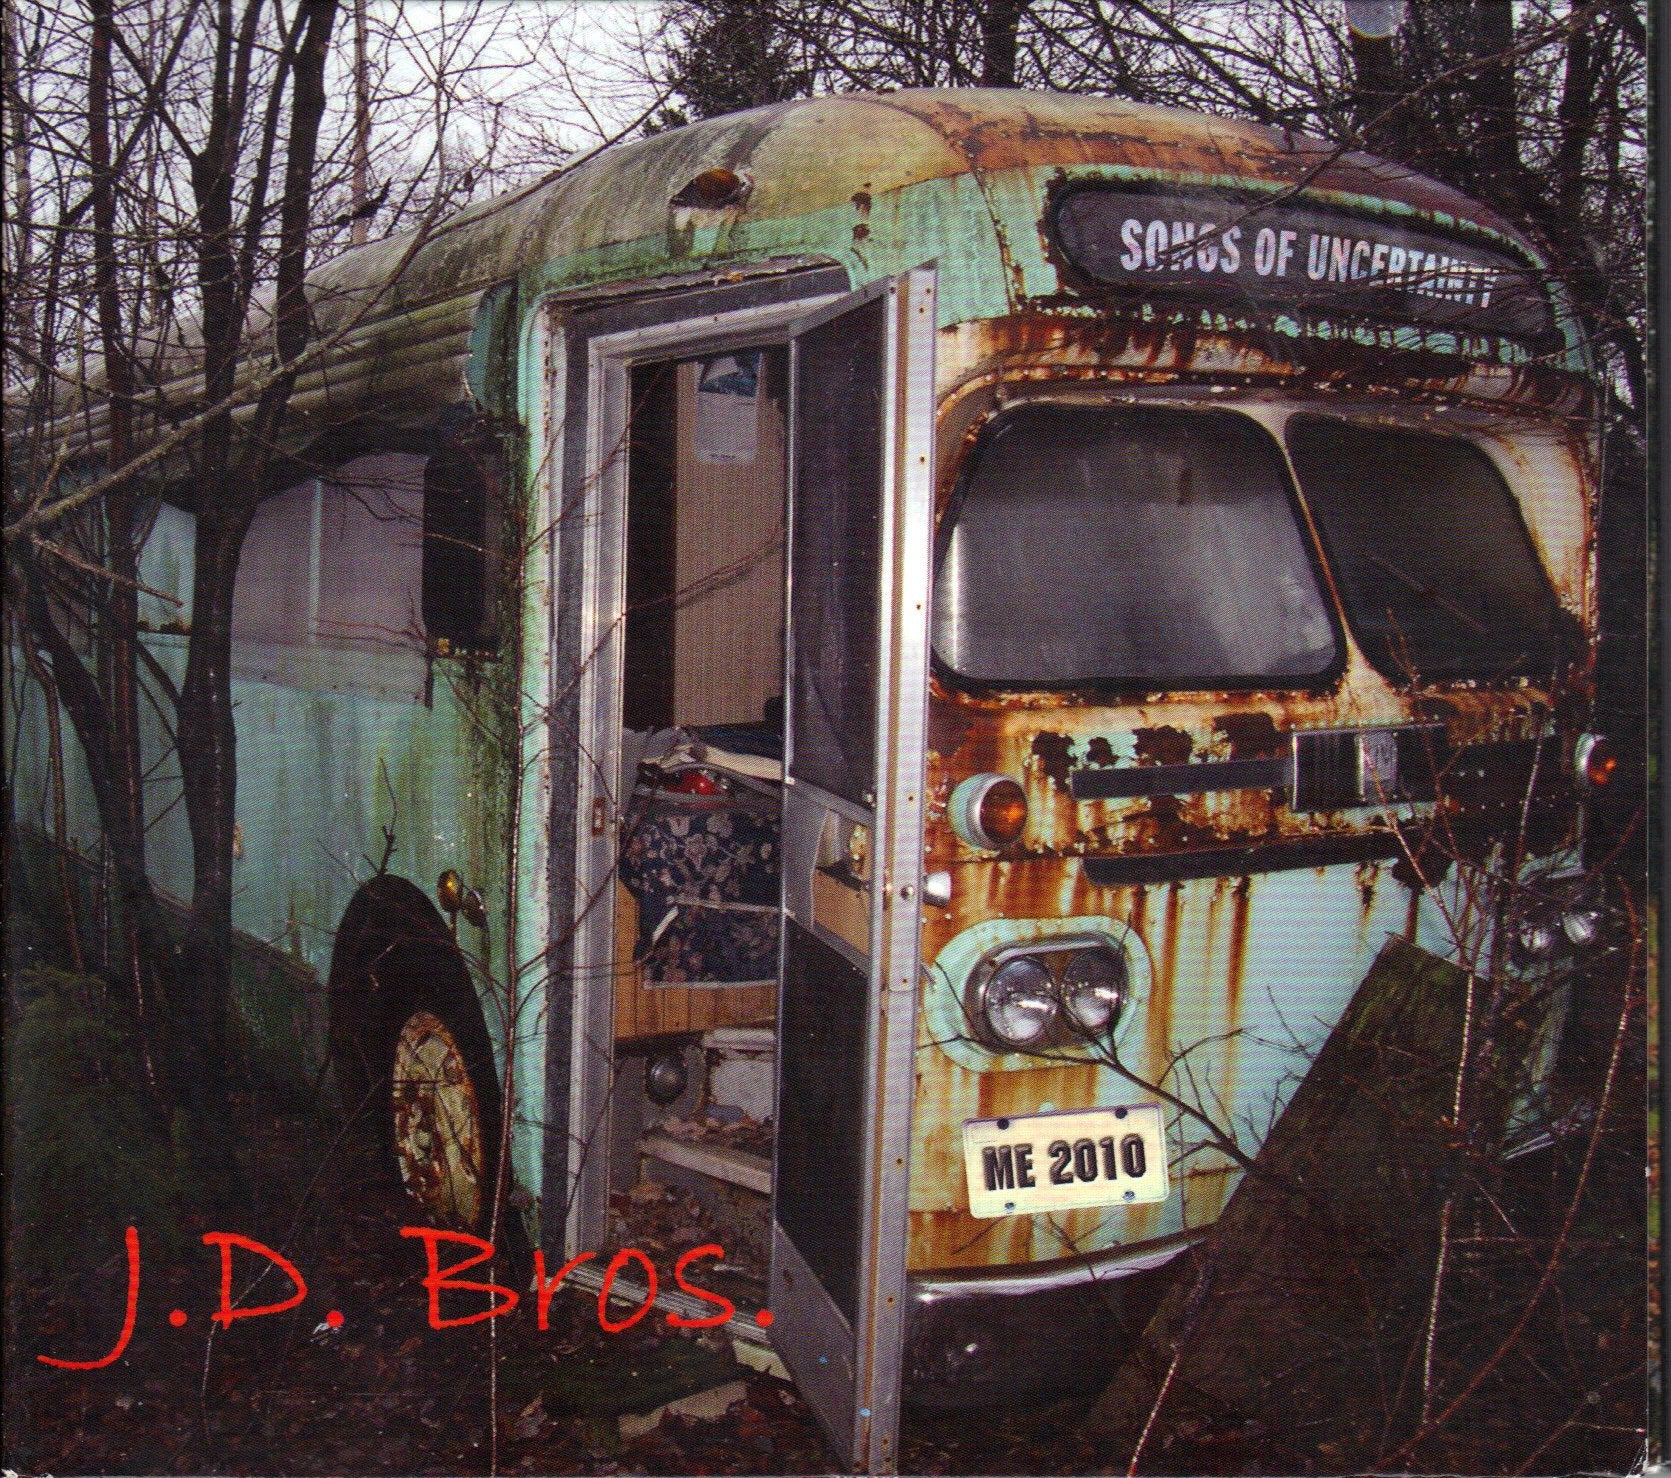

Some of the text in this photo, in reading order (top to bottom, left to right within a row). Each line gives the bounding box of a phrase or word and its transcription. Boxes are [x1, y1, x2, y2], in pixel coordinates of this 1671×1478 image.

[1119, 218, 1242, 274] SONGS
[1254, 227, 1298, 277] OF
[981, 1132, 1147, 1192] ME 2010
